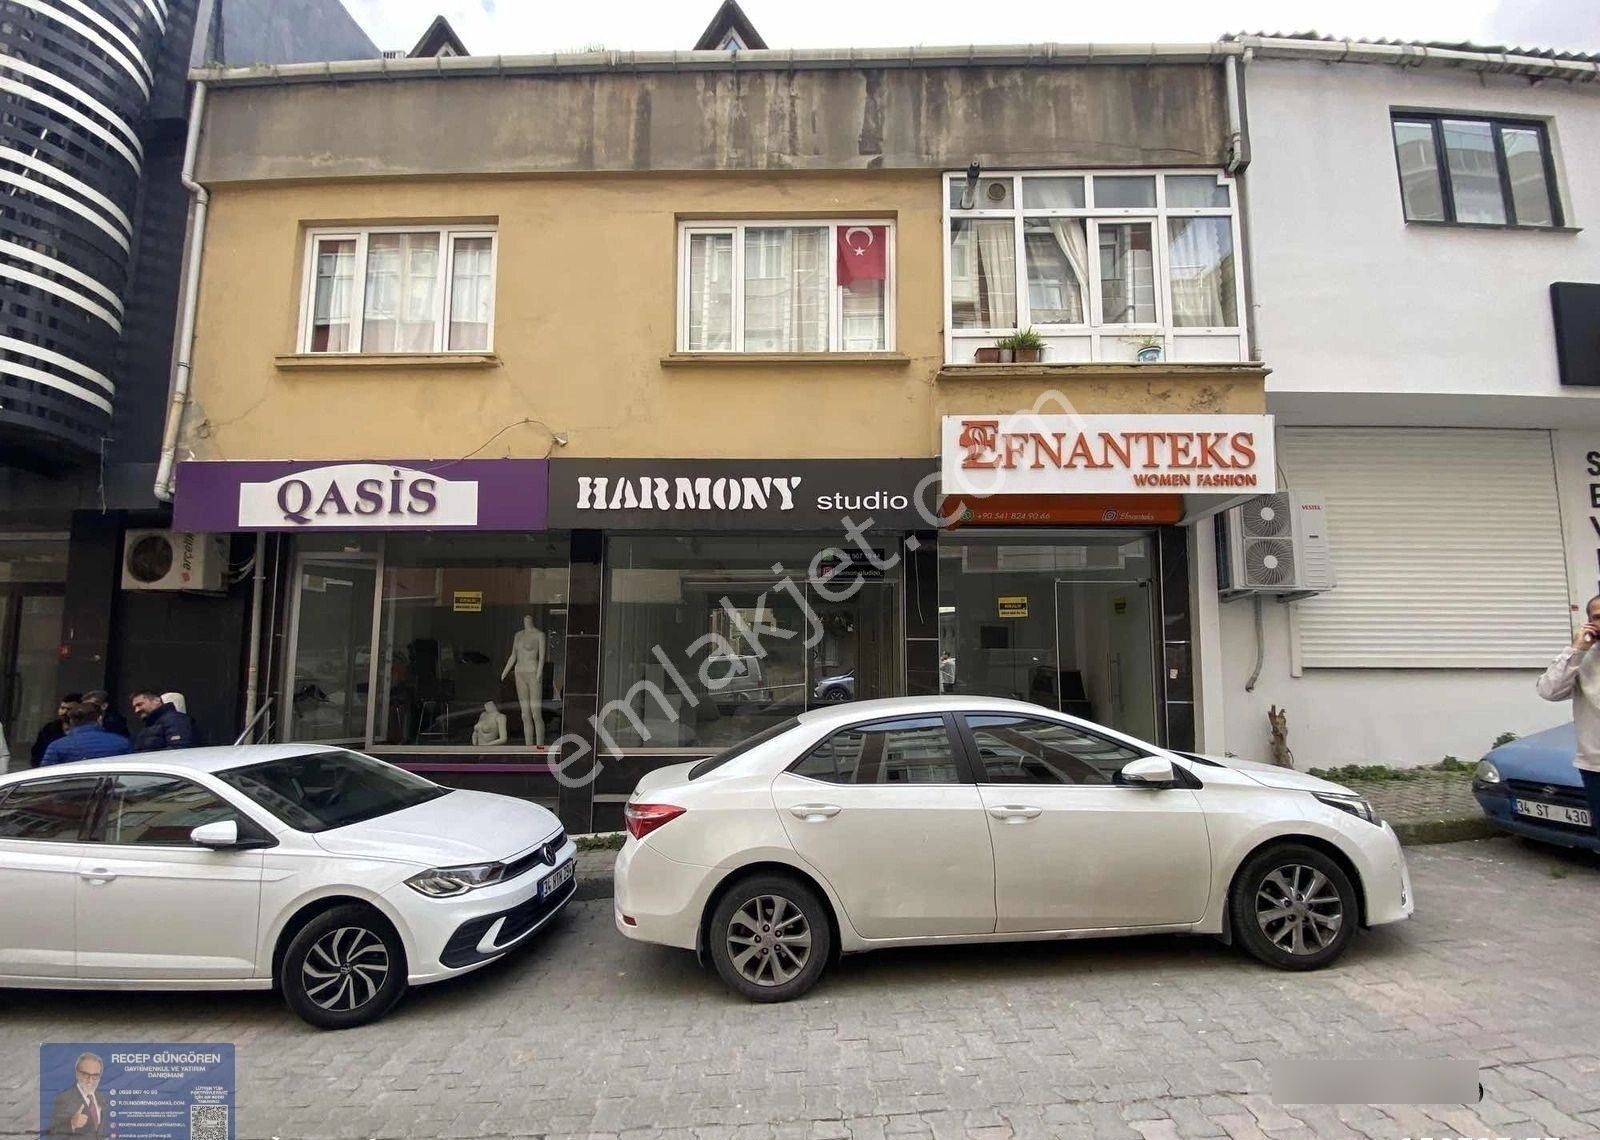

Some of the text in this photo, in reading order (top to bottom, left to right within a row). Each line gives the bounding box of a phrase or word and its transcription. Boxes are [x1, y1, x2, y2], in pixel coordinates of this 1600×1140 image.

[576, 476, 909, 511] HARMONY studio
[1133, 474, 1257, 487] WOMEN FASHION
[277, 469, 437, 525] QASİS
[1517, 800, 1588, 824] 34 ST 430
